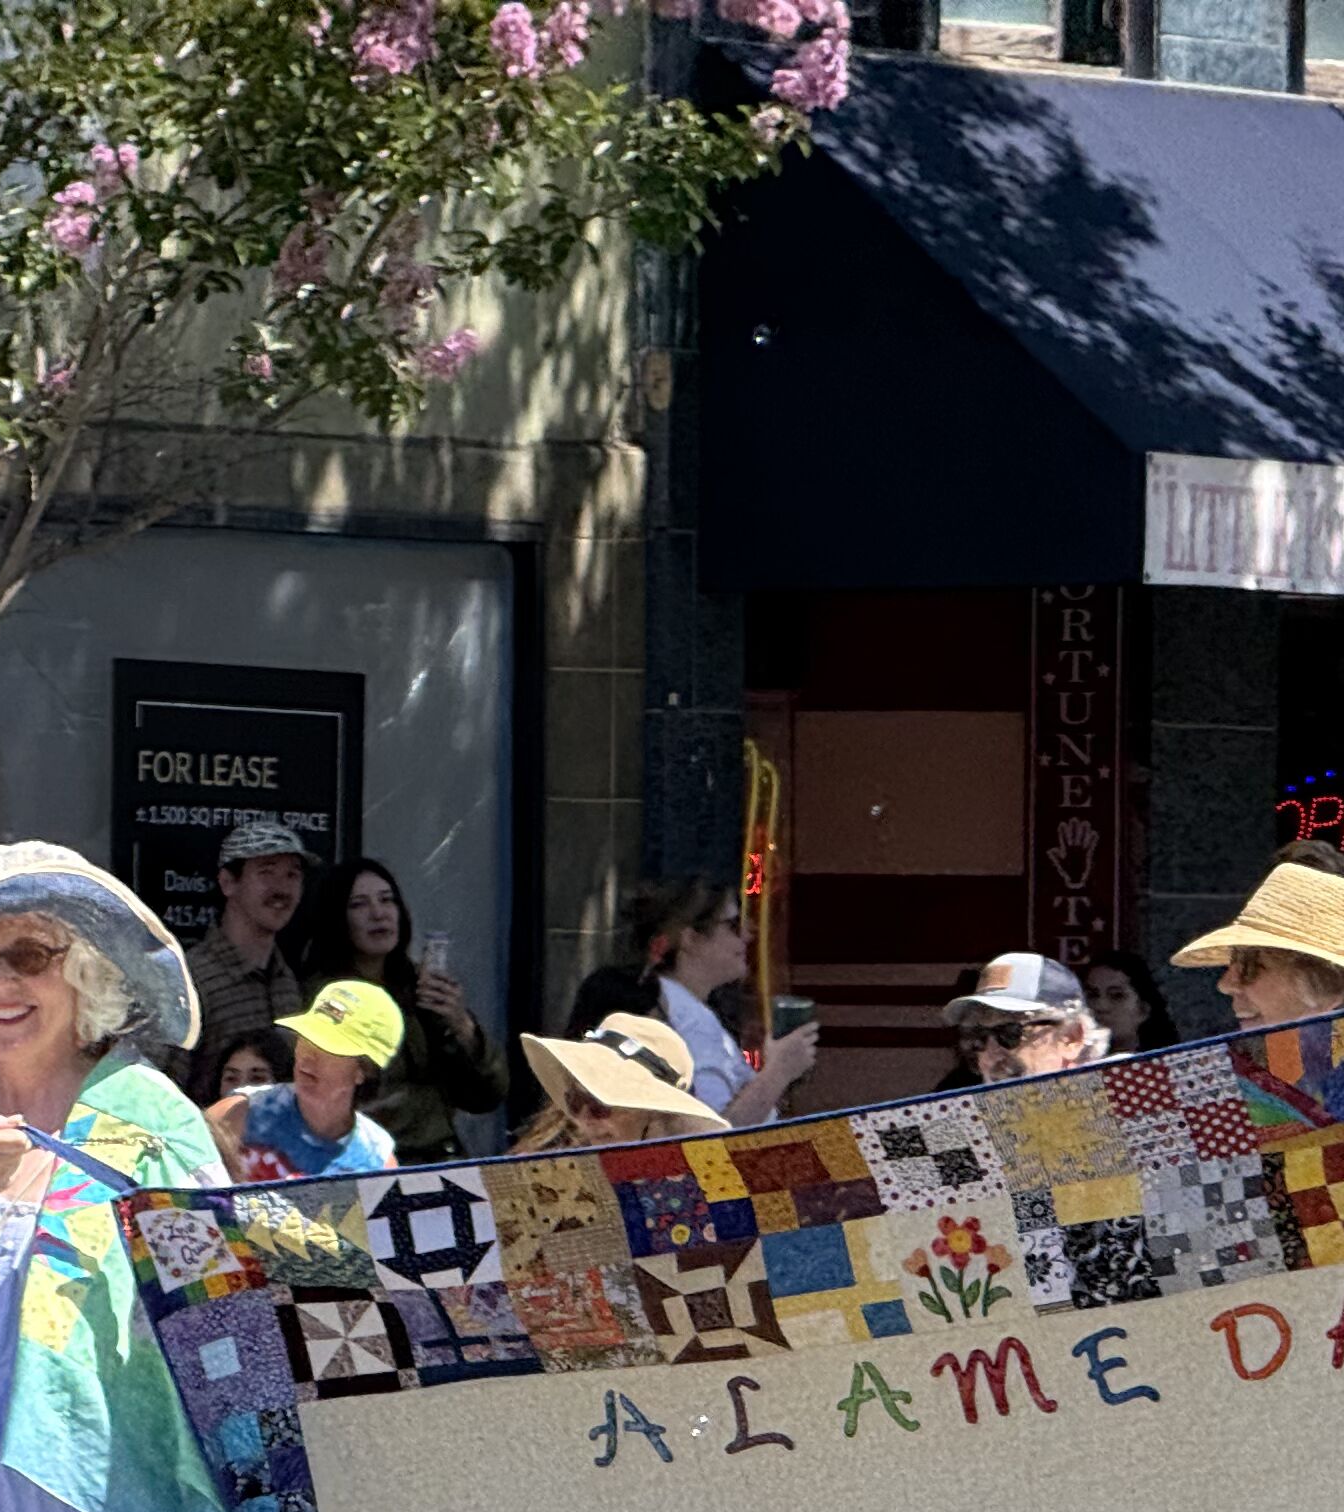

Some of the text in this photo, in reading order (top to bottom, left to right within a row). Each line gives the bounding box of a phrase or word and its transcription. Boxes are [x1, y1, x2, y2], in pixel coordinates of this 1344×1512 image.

[137, 751, 280, 789] FOR LEASE
[283, 812, 331, 832] SPACE
[163, 870, 207, 892] Davis
